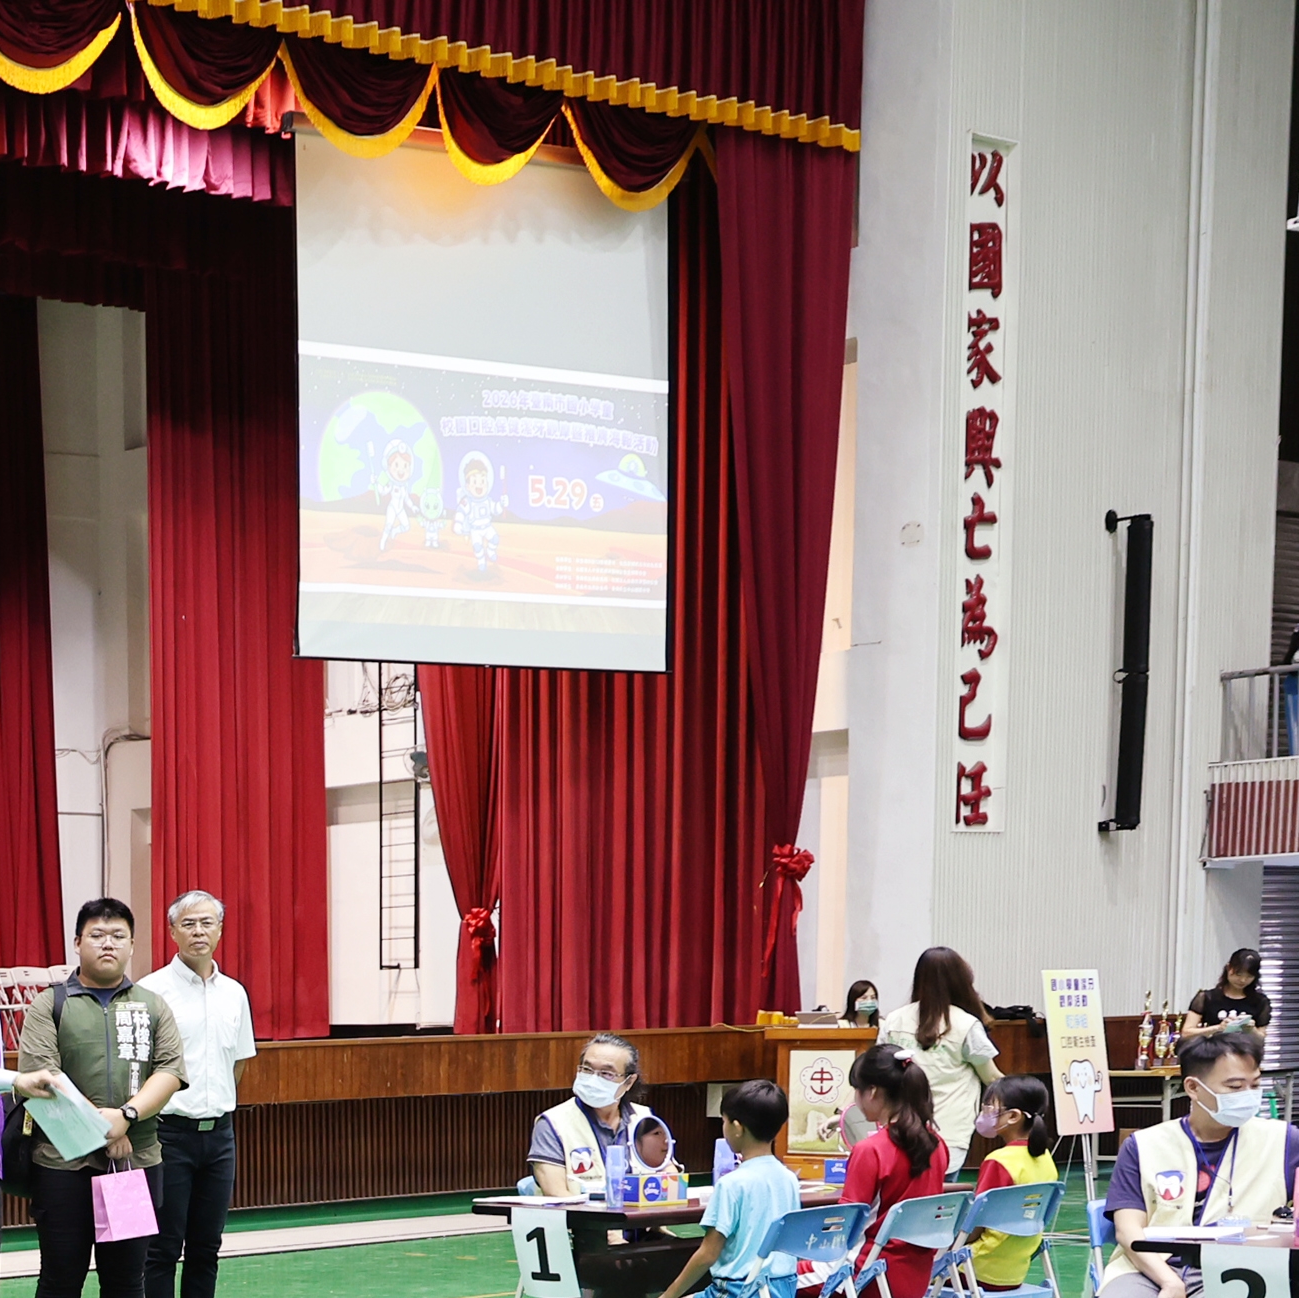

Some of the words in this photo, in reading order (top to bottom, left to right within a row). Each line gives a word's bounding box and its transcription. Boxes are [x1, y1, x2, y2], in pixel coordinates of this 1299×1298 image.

[528, 475, 587, 511] 5.29
[955, 149, 1006, 828] 以國家興亡為己任
[527, 1227, 561, 1283] 1
